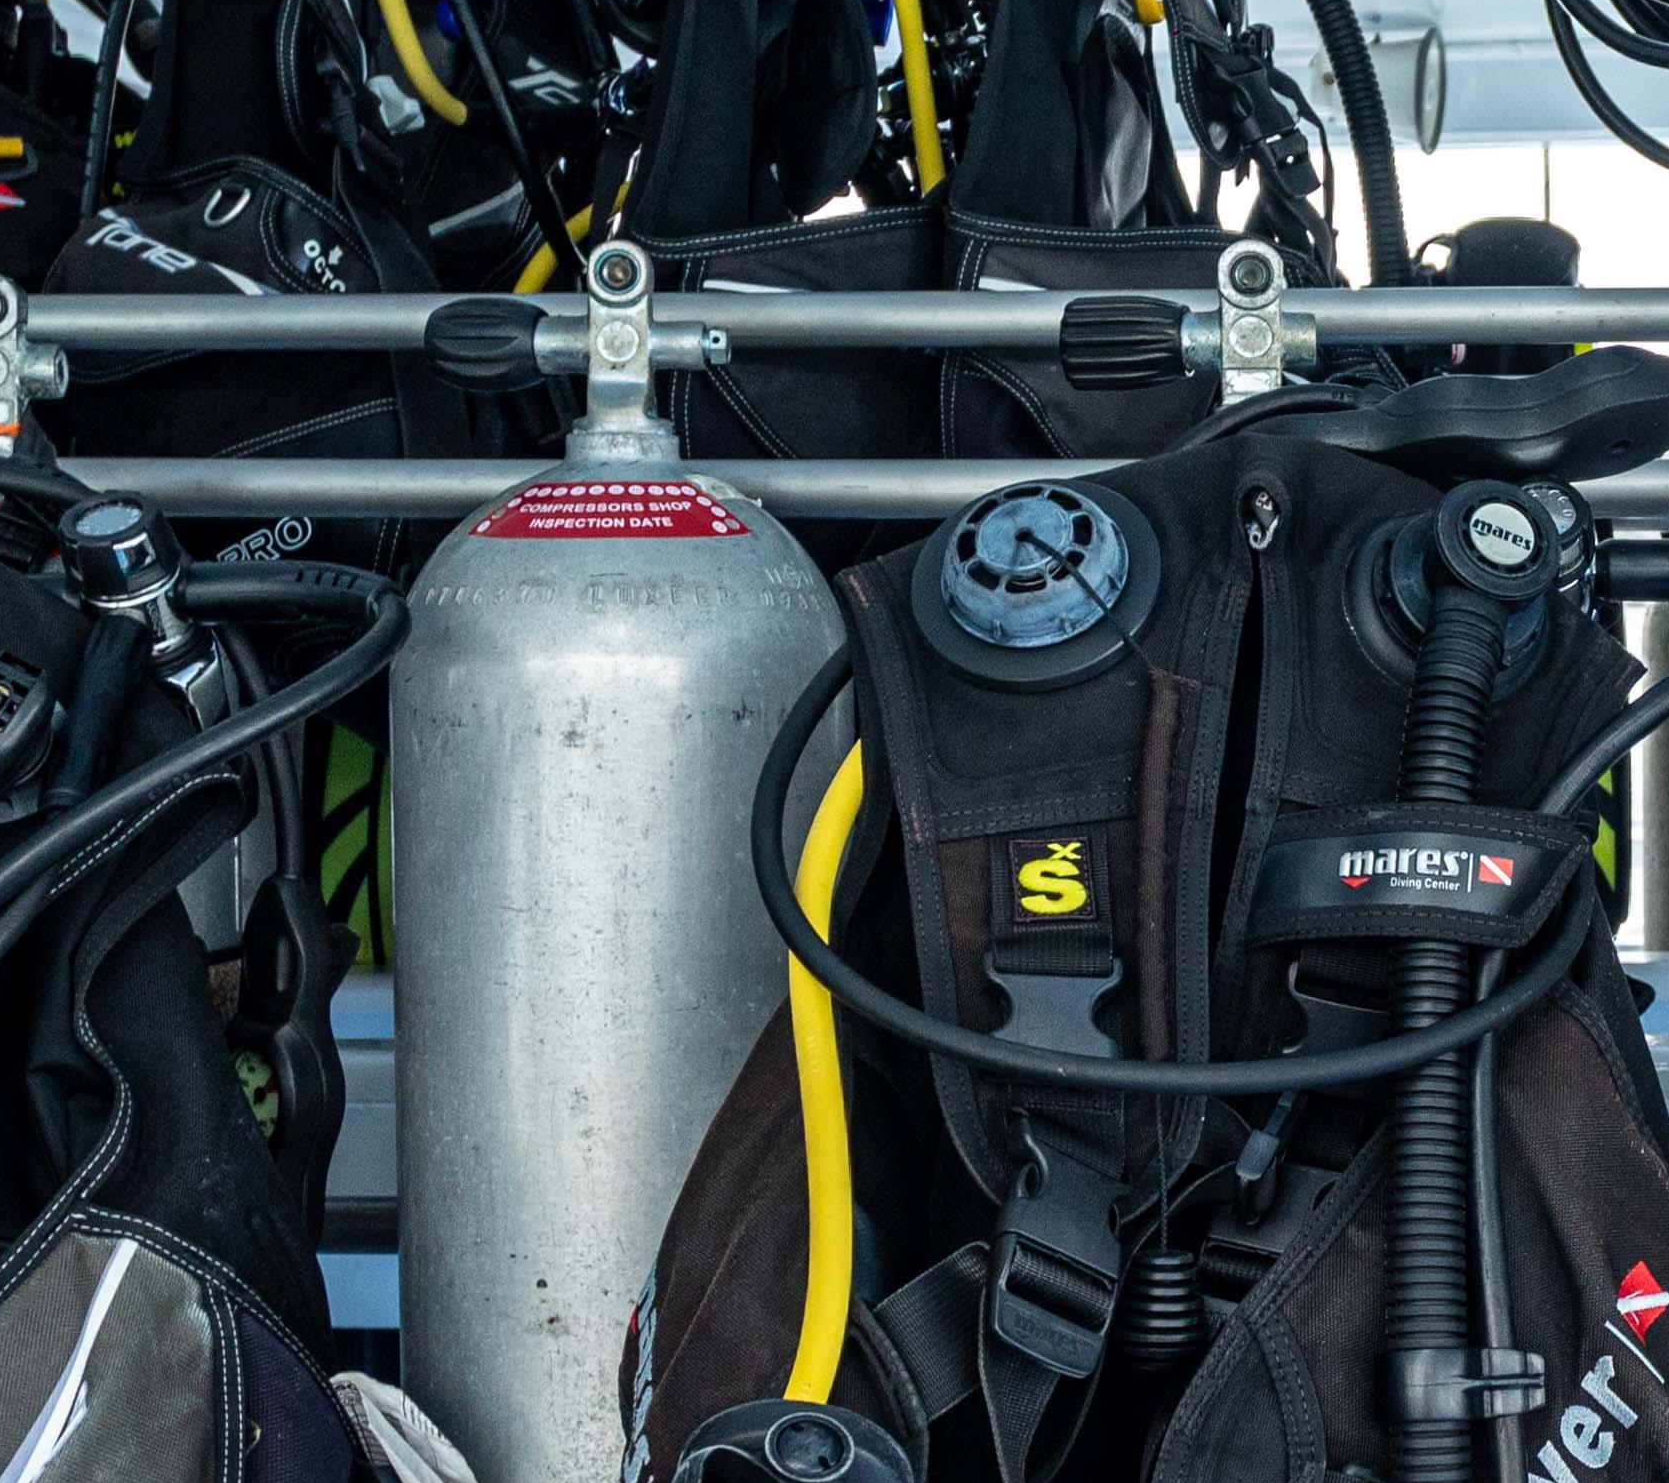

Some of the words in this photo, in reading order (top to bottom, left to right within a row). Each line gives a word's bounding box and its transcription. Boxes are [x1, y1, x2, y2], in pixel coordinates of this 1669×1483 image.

[85, 207, 198, 273] Tone
[519, 501, 645, 515] COMPRESSORS
[648, 500, 693, 513] SHOP
[529, 517, 627, 529] INSPECTION
[629, 516, 674, 529] DATE
[1471, 518, 1533, 552] mares
[1339, 847, 1462, 879] mares
[1389, 876, 1421, 890] Diving
[1422, 876, 1461, 891] Center
